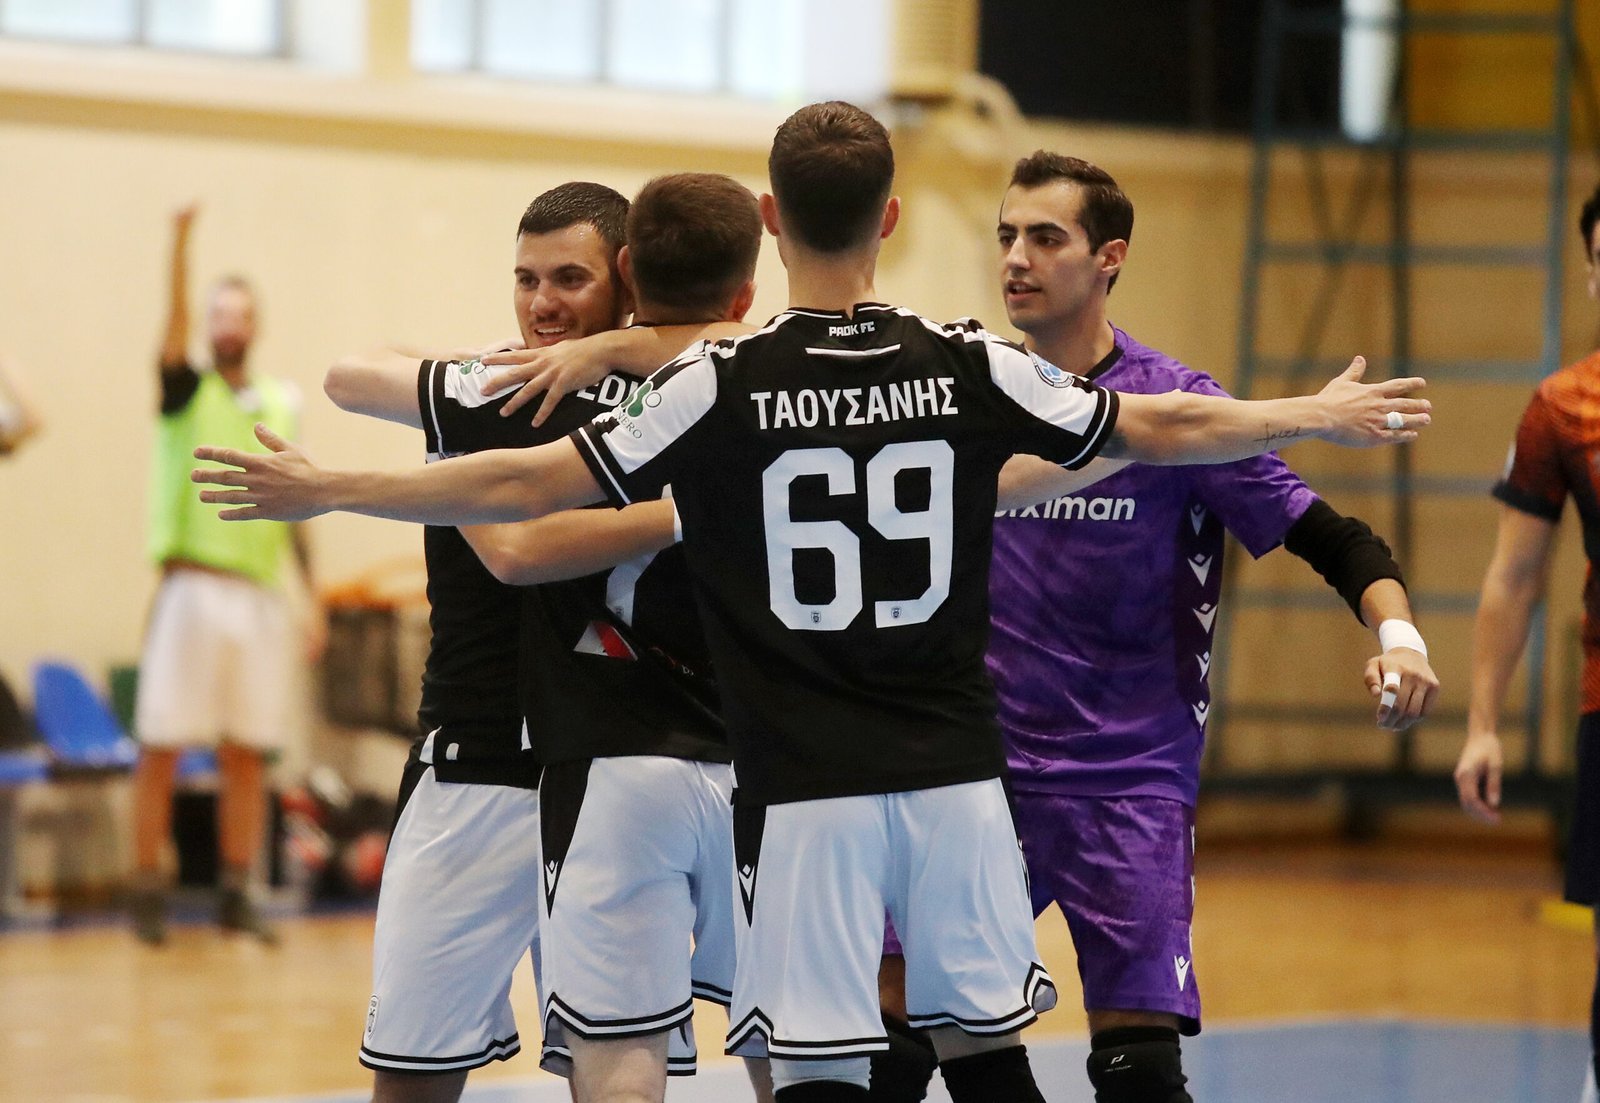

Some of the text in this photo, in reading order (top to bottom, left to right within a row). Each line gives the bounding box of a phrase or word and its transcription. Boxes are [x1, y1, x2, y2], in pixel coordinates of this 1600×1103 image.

[829, 321, 876, 337] PAOK FC
[751, 378, 958, 429] ΤΑΟΥΣΑΝΗΣ
[762, 439, 955, 631] 69
